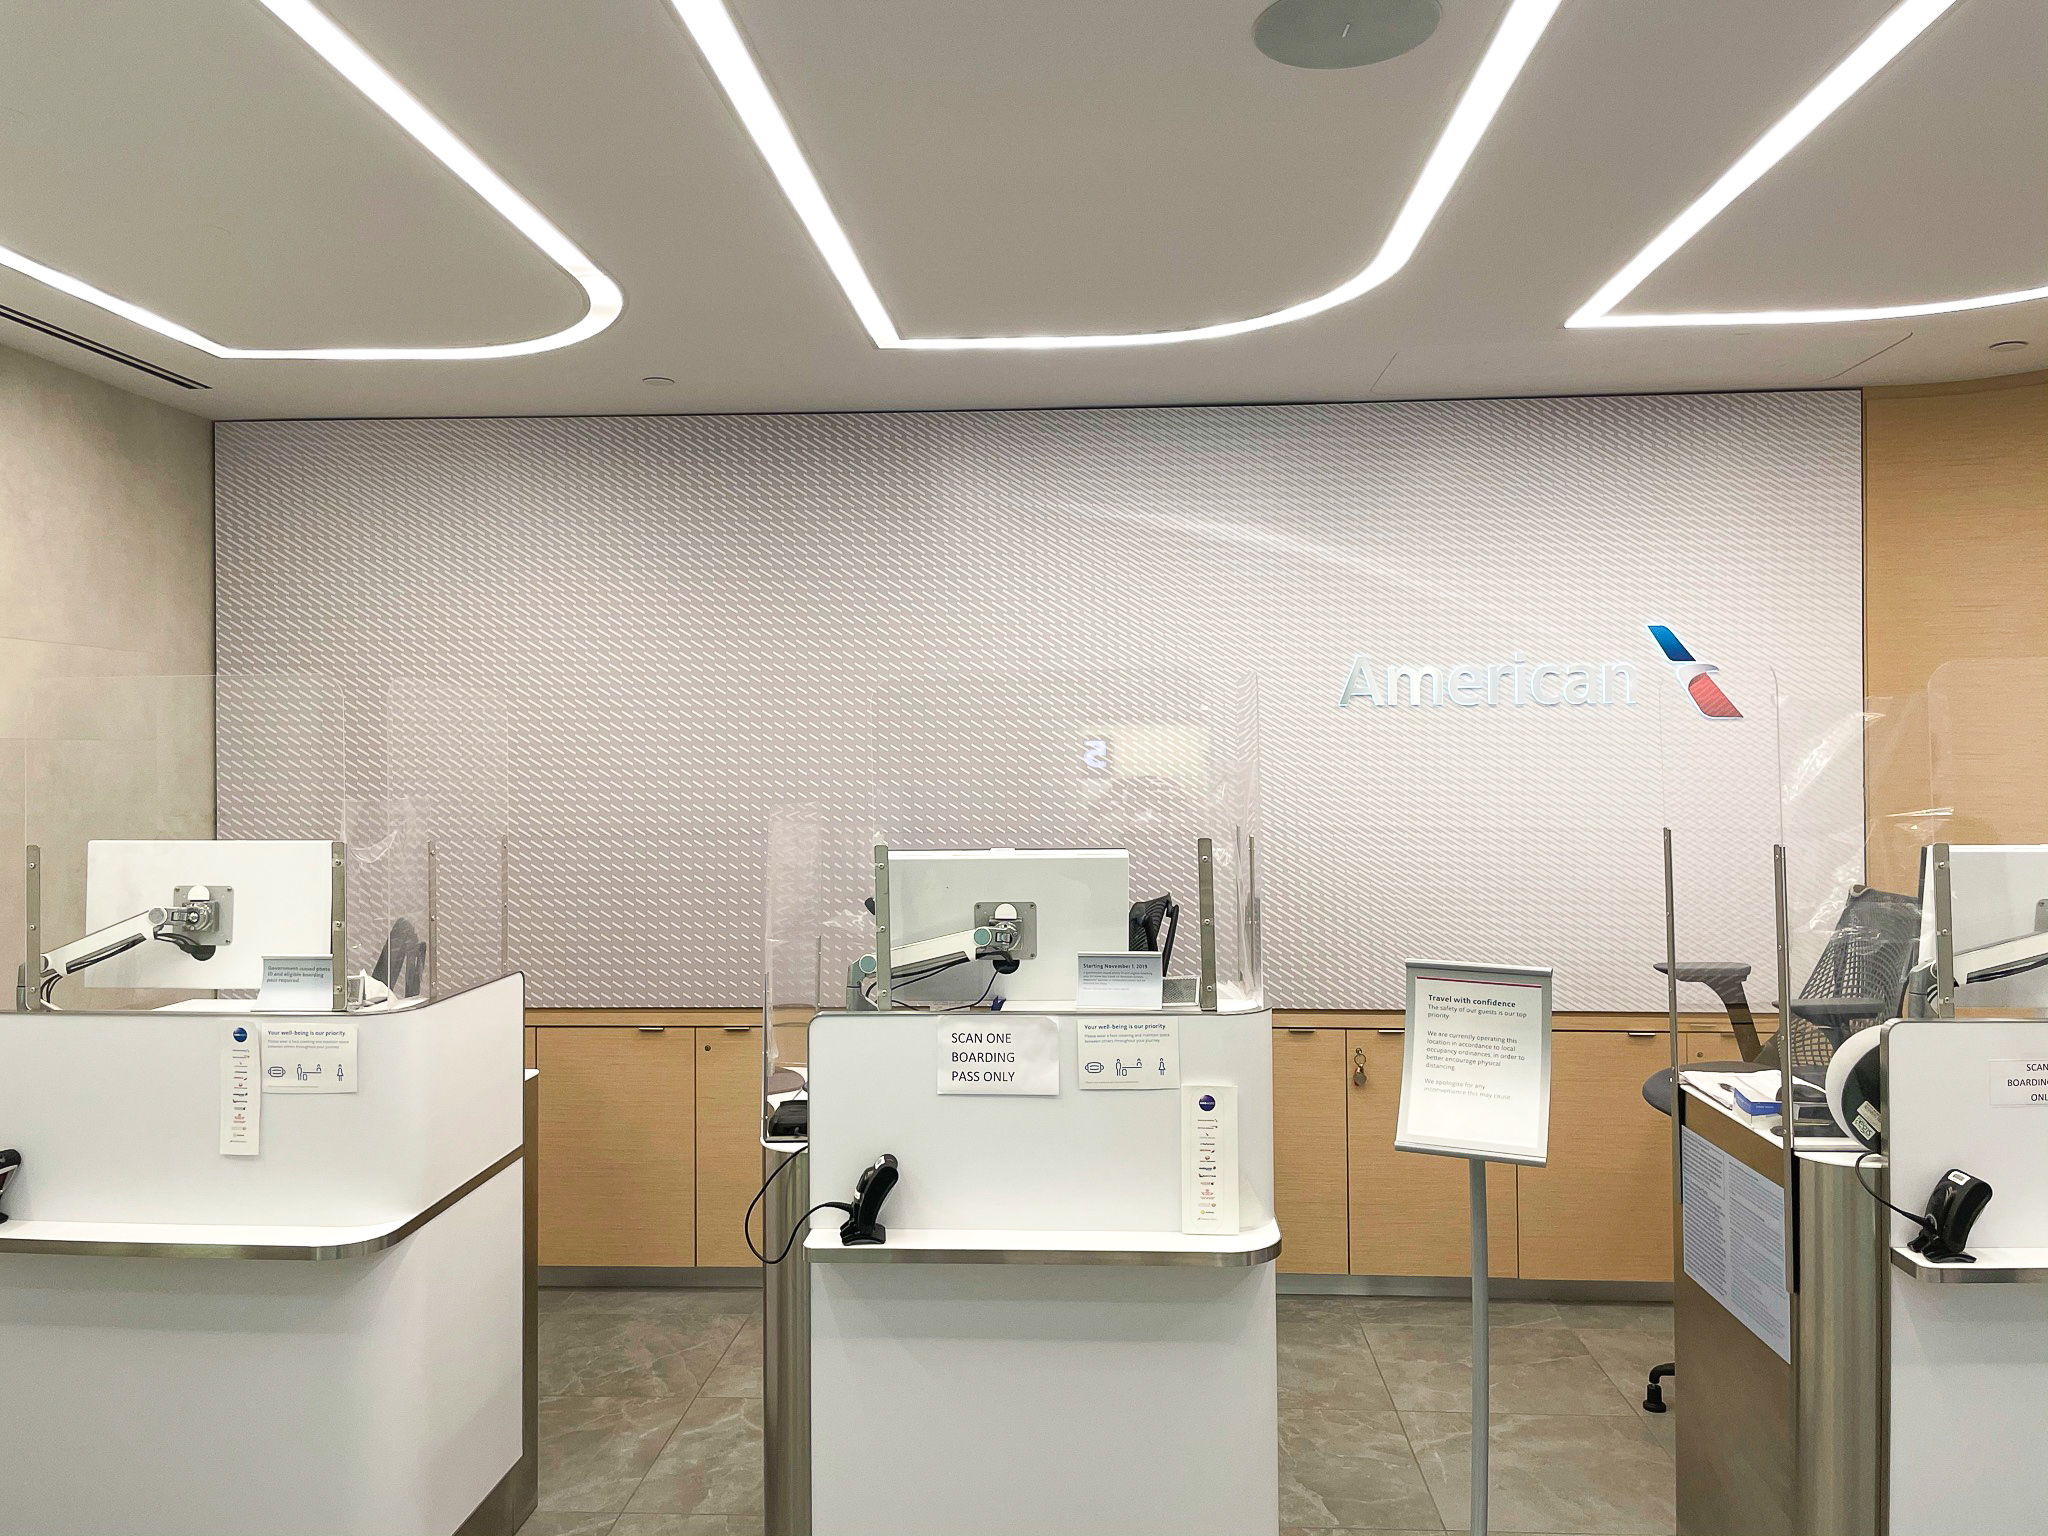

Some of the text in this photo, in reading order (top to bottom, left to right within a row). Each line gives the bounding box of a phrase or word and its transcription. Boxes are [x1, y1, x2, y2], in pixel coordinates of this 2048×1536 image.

[1338, 652, 1638, 707] American
[1428, 994, 1452, 1003] Travel
[1472, 998, 1516, 1008] confidence
[1440, 1005, 1457, 1014] safety
[1427, 1012, 1450, 1020] priority
[951, 1032, 1012, 1044] SCAN ONE
[1449, 1033, 1475, 1042] currently
[1476, 1035, 1506, 1044] operating
[1426, 1038, 1450, 1046] location
[1458, 1041, 1492, 1050] accordance
[1426, 1047, 1457, 1056] occupancy
[951, 1051, 1015, 1063] BOARDING
[1445, 1057, 1477, 1066] encourage
[2026, 1063, 2048, 1071] SCAN
[951, 1070, 1015, 1082] PASS ONLY
[1435, 1080, 1464, 1088] apologize
[2007, 1078, 2048, 1086] BOARDIN
[2031, 1093, 2048, 1101] ONL
